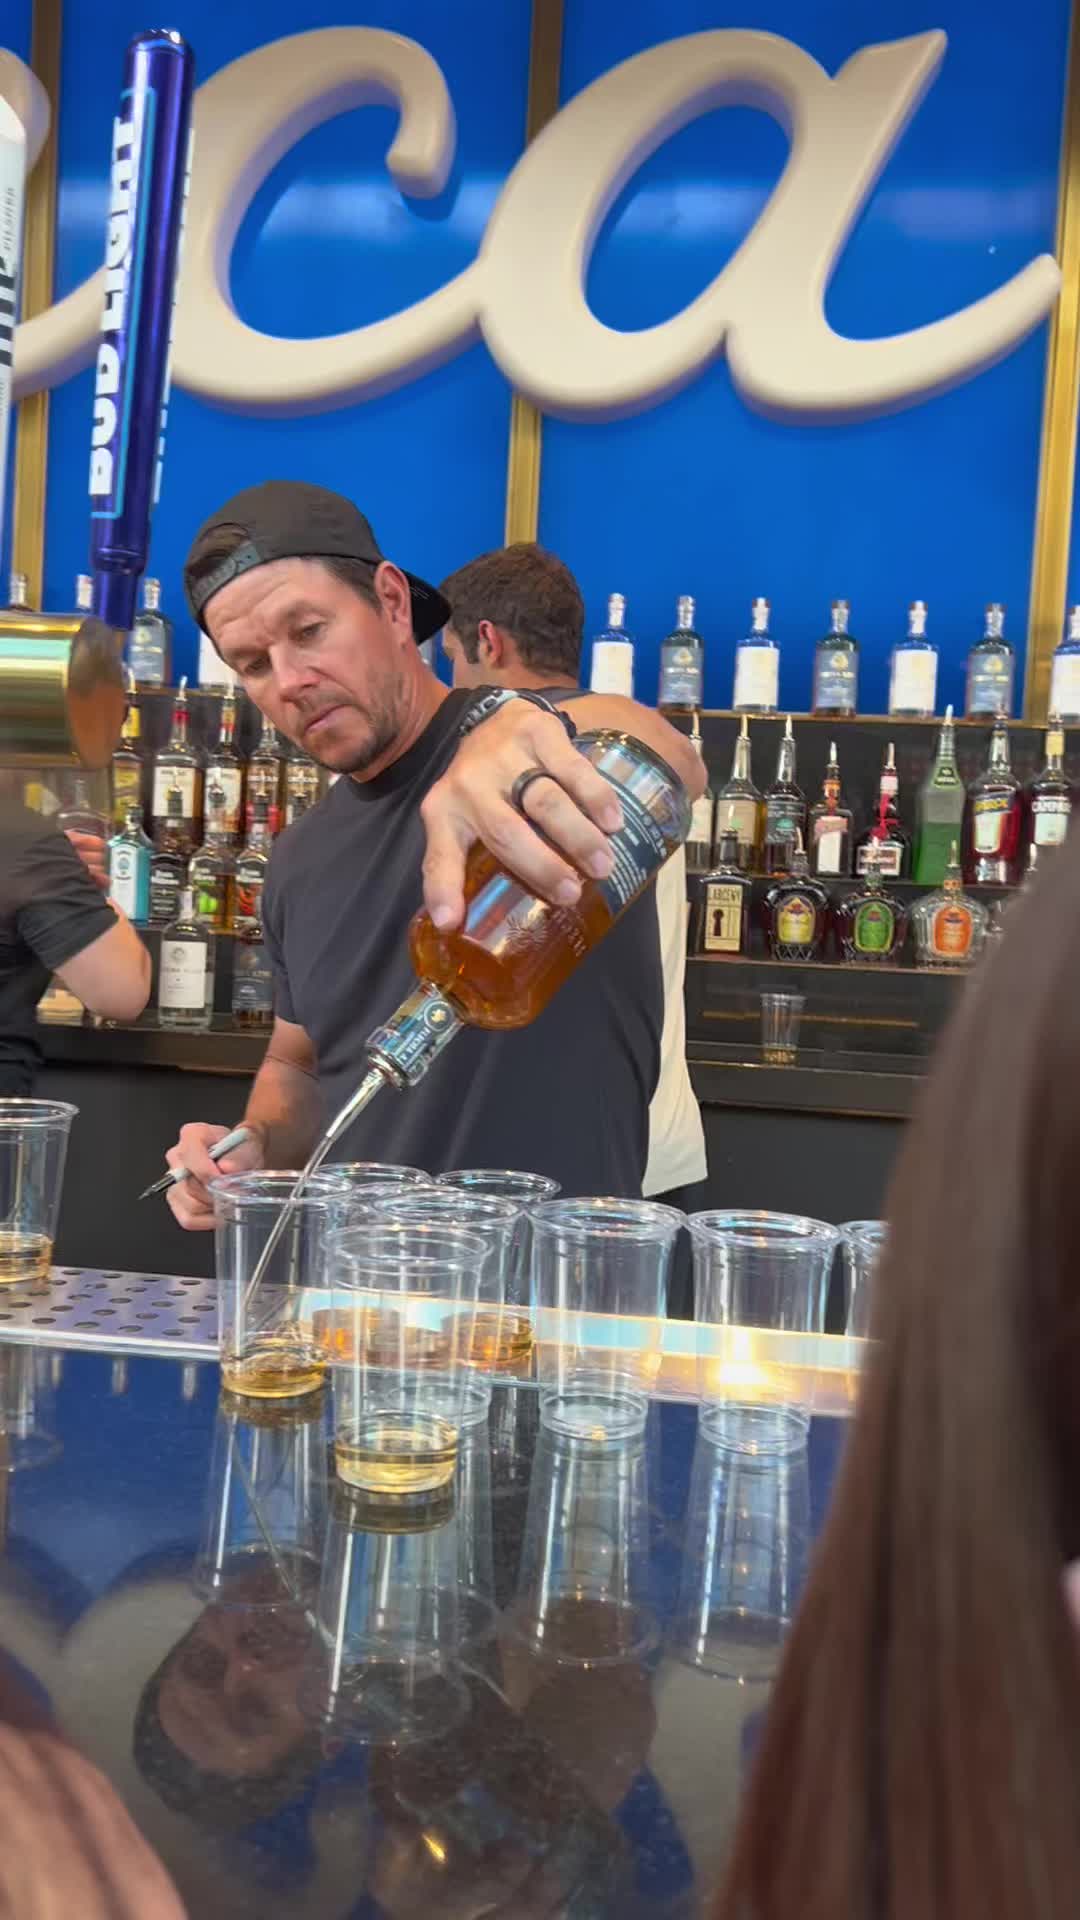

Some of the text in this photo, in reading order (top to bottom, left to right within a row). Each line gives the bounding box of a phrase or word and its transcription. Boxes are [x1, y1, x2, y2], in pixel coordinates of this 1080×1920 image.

[0, 26, 1062, 418] ca
[89, 116, 137, 495] BUD LIGHT
